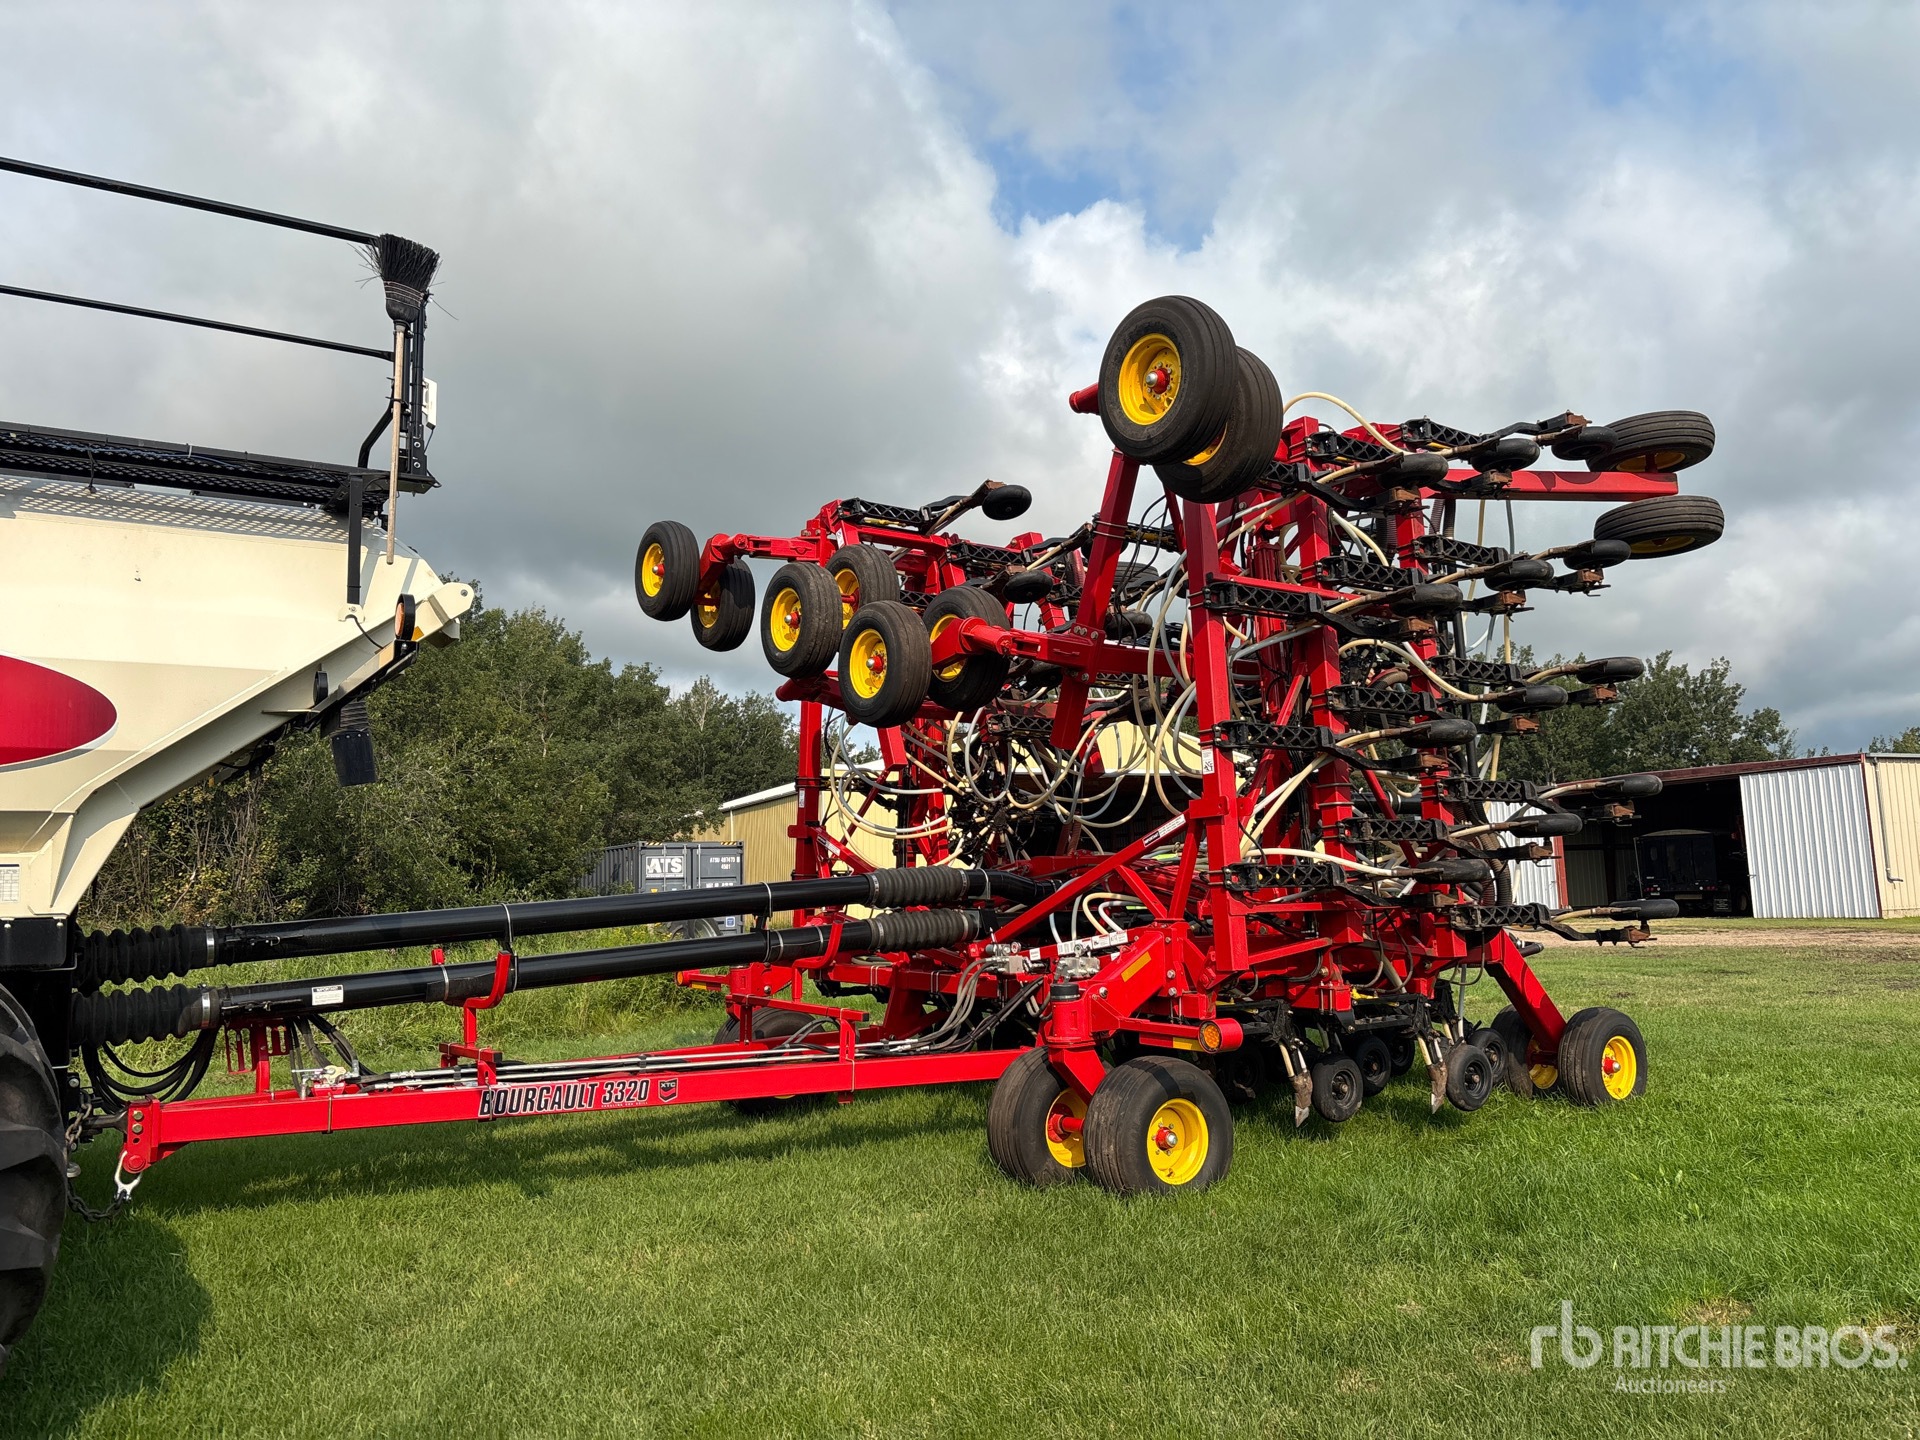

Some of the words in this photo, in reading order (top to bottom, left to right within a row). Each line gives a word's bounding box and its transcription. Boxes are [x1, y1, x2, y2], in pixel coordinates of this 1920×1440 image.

[647, 857, 682, 874] ATS
[478, 1081, 599, 1117] BOURGAULT
[602, 1079, 650, 1105] 3320
